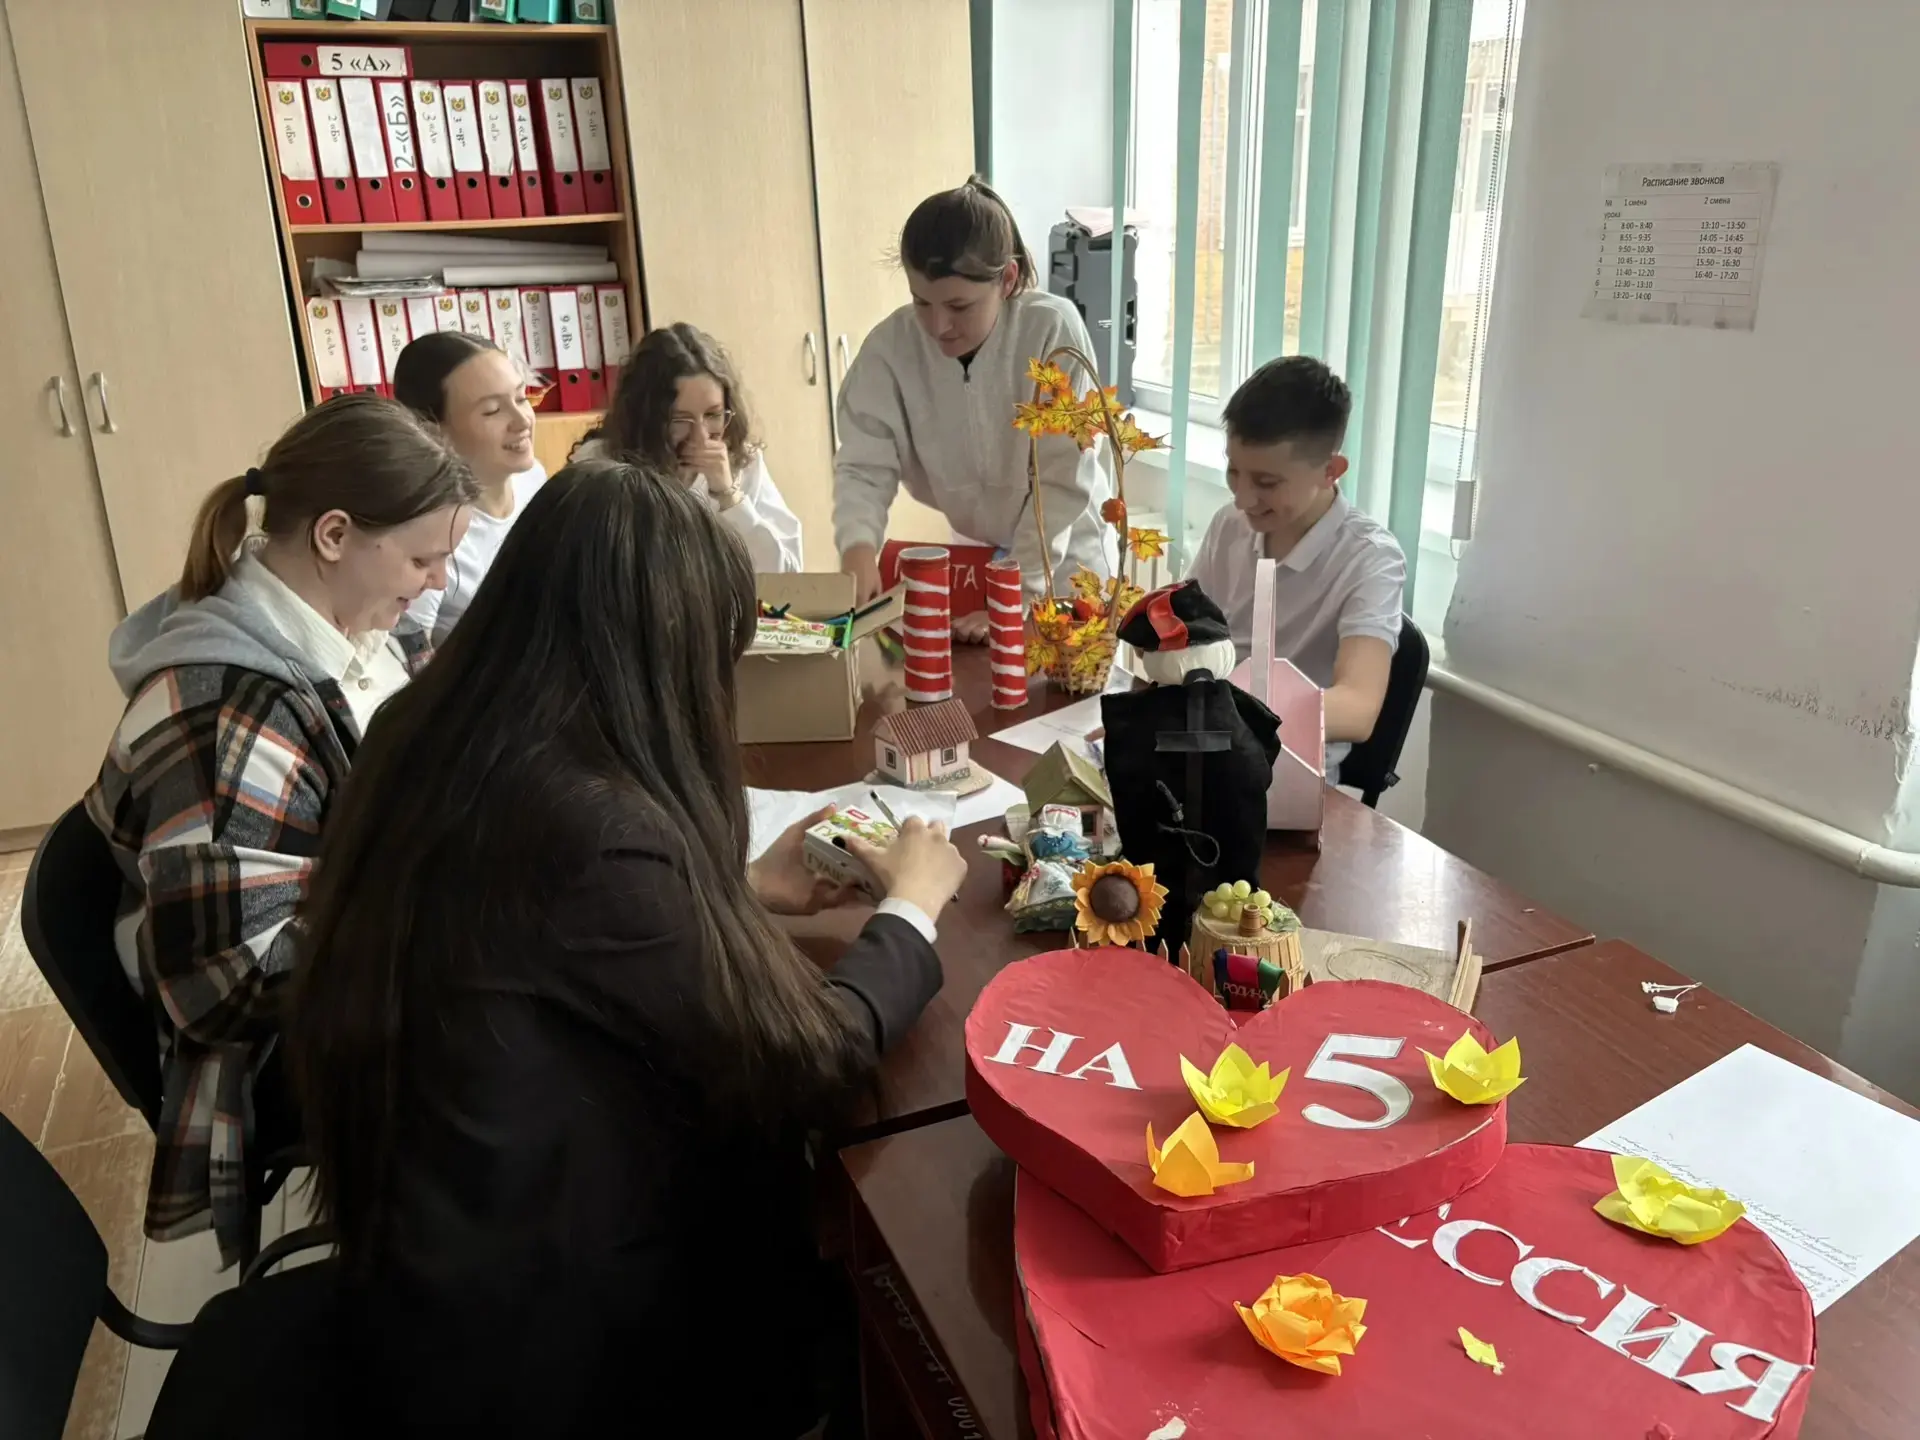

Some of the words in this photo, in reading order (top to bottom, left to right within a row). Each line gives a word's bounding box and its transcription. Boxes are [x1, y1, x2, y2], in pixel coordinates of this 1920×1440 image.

[331, 53, 343, 70] 5
[350, 54, 391, 71] «А»
[387, 95, 416, 169] 2-«Б»
[1642, 177, 1688, 187] Расписание
[1690, 176, 1725, 186] звонков
[1701, 221, 1719, 229] 13:10
[1727, 221, 1746, 229] 13:50
[1700, 234, 1718, 242] 14:05
[1725, 234, 1744, 242] 14:45
[1637, 245, 1654, 253] 10:30
[1698, 246, 1716, 254] 15:00
[1723, 247, 1743, 255] 15:40
[1696, 258, 1715, 266] 15:50
[1722, 259, 1740, 267] 16:30
[1616, 268, 1632, 276] 11:40
[1694, 271, 1713, 279] 16:40
[1720, 271, 1739, 279] 17:20
[1613, 291, 1629, 299] 13:20
[1635, 292, 1652, 300] 14:00
[808, 853, 844, 881] ГУАШ
[1223, 982, 1268, 1000] РОДИНА
[983, 1020, 1143, 1091] НА
[1301, 1032, 1414, 1130] 5
[1375, 1202, 1815, 1423] ССИЯ
